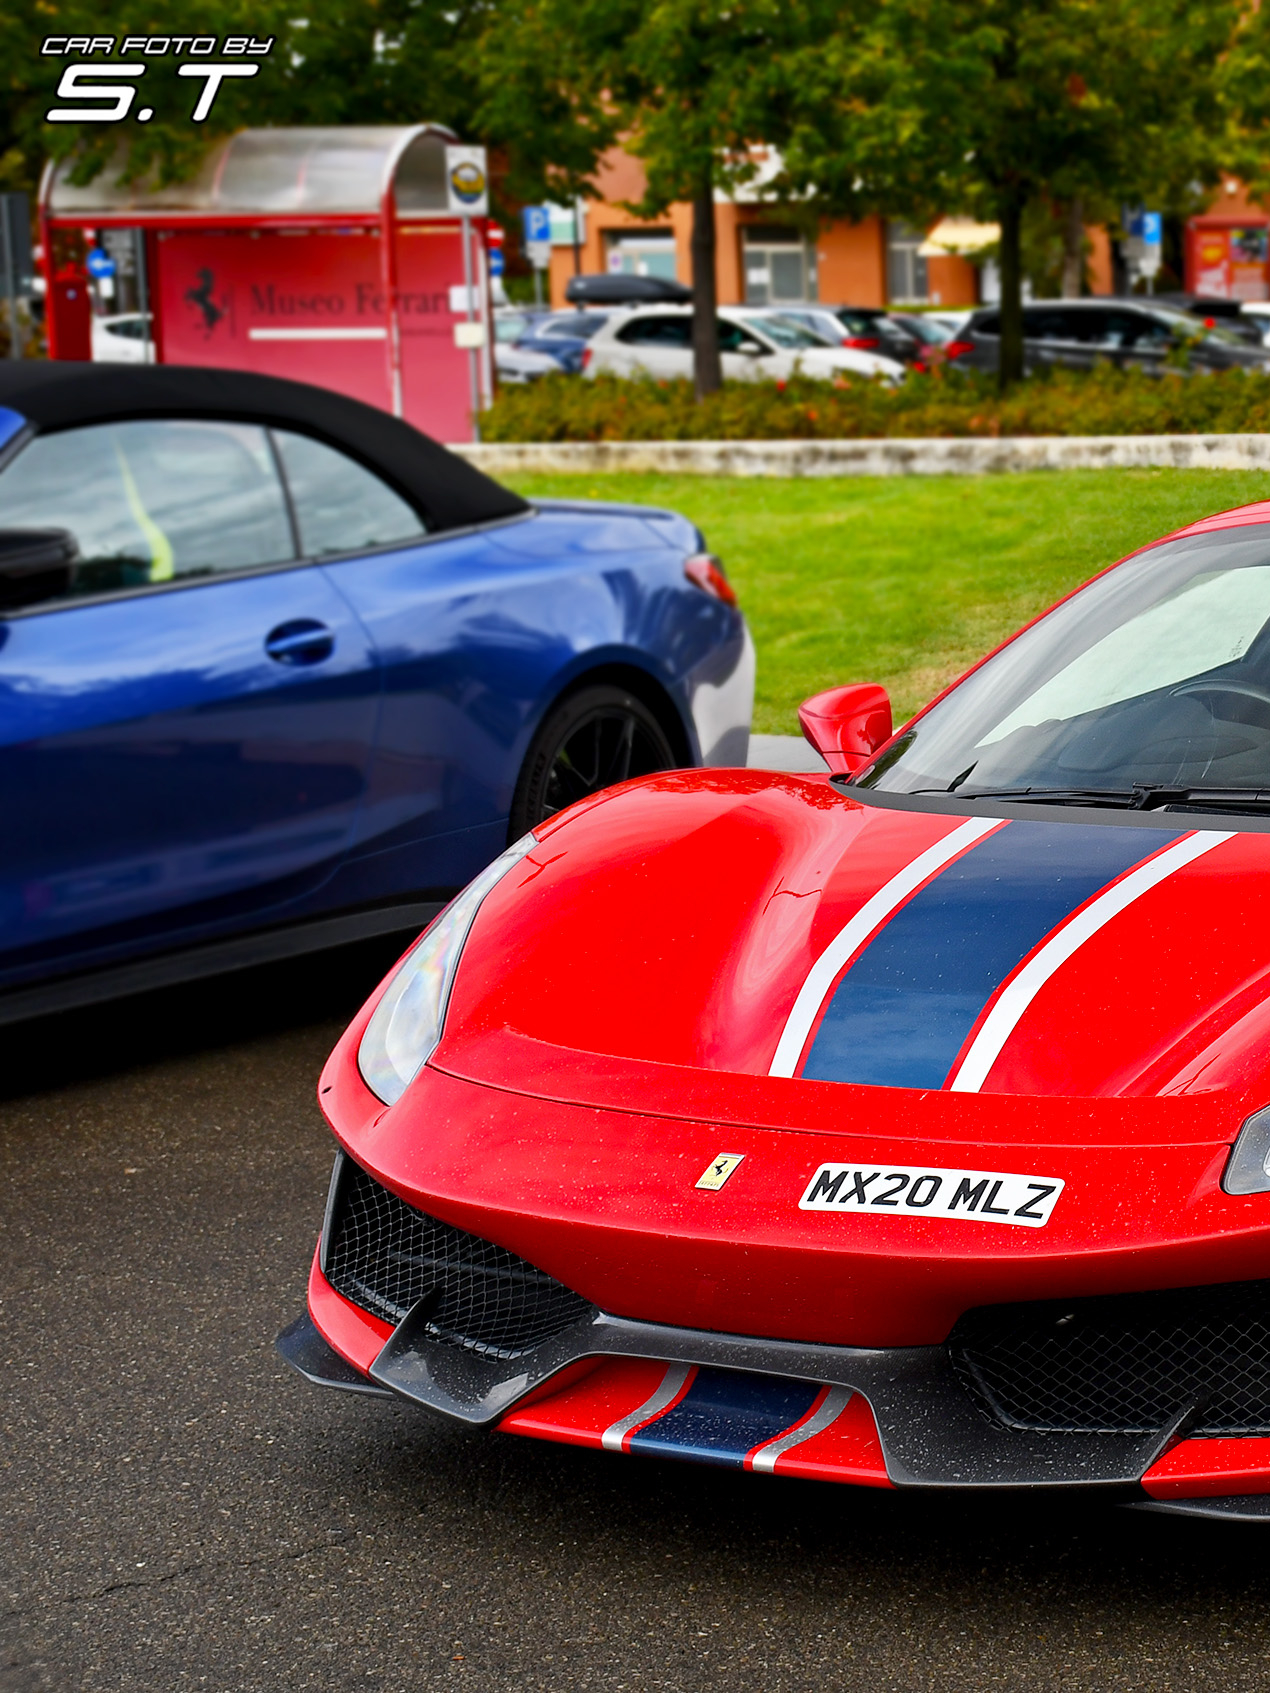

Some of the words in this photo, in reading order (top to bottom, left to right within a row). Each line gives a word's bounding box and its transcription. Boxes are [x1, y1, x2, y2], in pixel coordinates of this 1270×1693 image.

[250, 283, 345, 316] Museo
[807, 1169, 943, 1208] MX20
[947, 1177, 1057, 1219] MLZ
